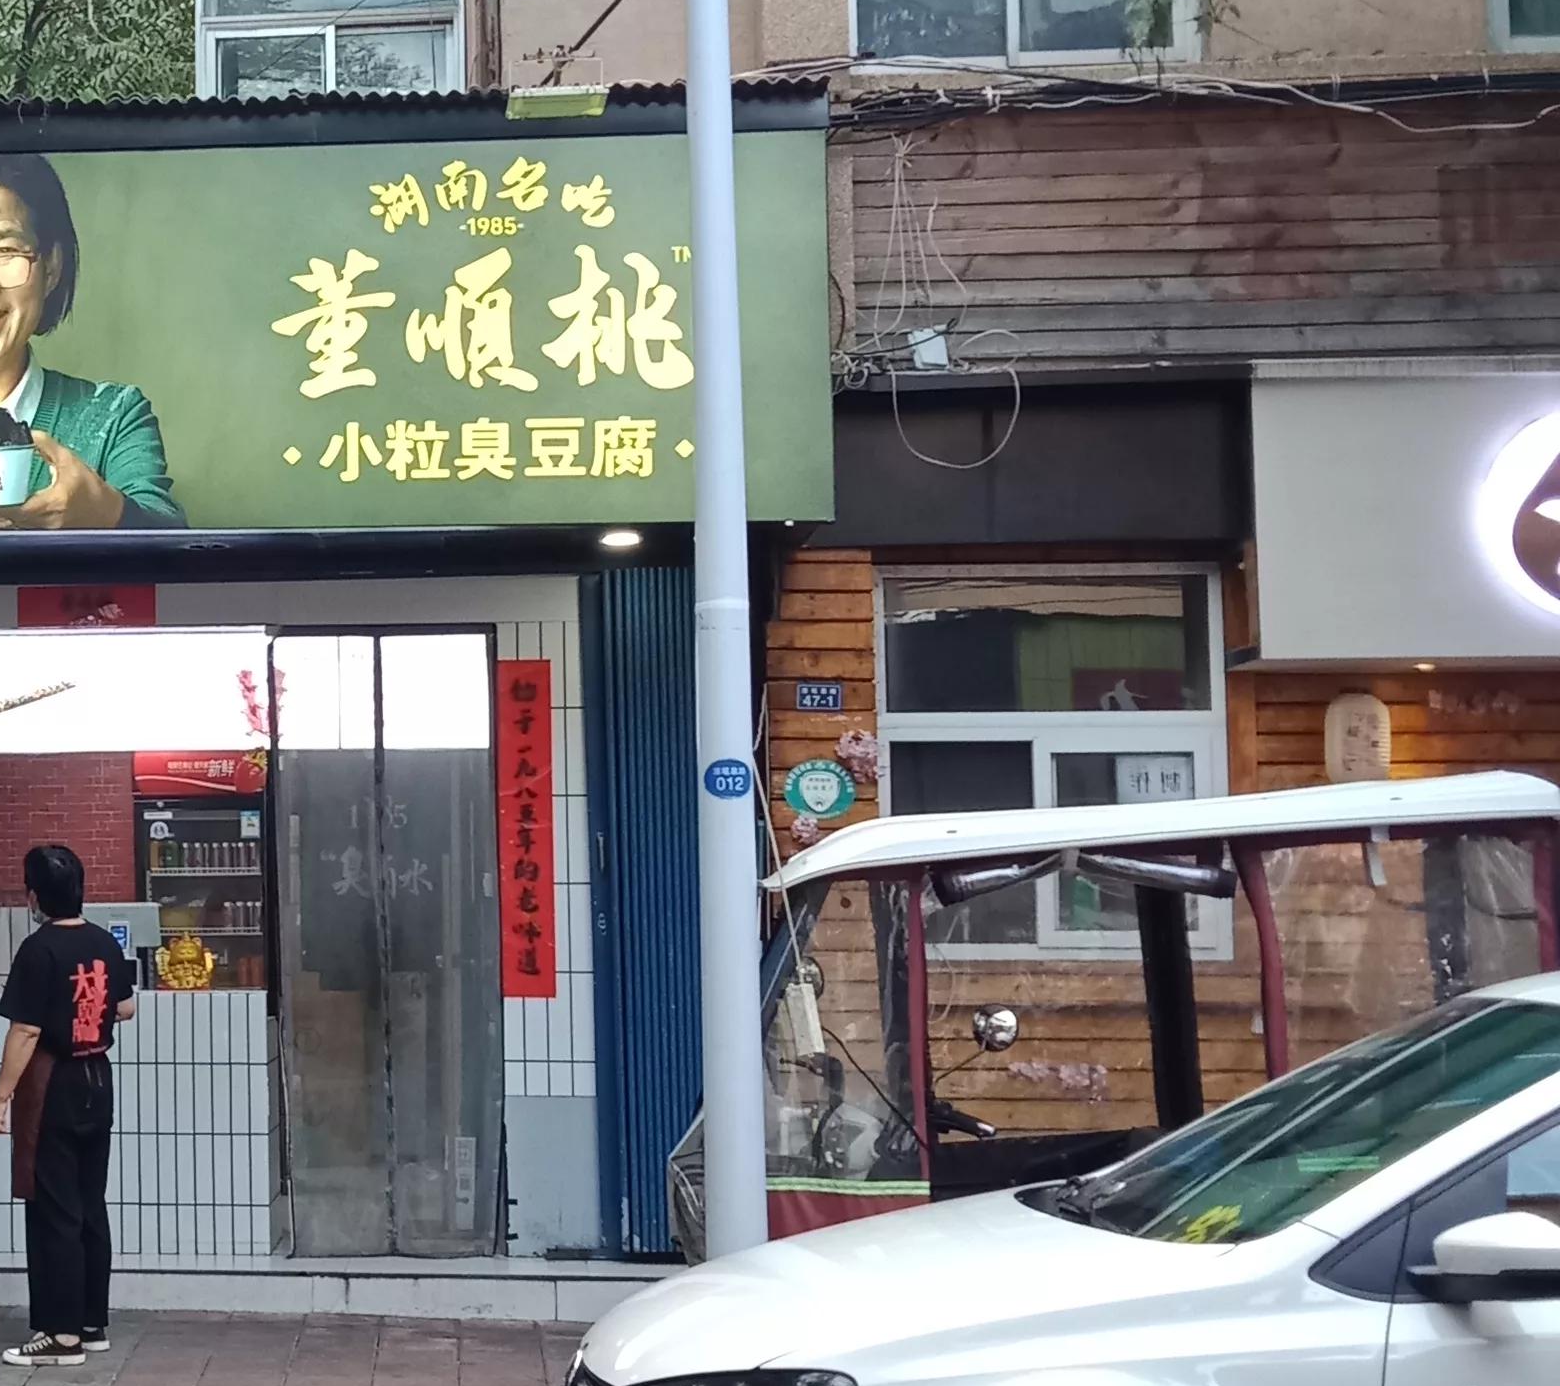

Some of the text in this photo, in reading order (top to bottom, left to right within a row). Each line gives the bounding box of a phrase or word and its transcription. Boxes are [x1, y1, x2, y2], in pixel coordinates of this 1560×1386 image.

[368, 156, 616, 233] 湖南名吃
[319, 415, 657, 483] 小粒臭豆腐
[802, 695, 834, 707] 47-1
[715, 776, 745, 791] 012
